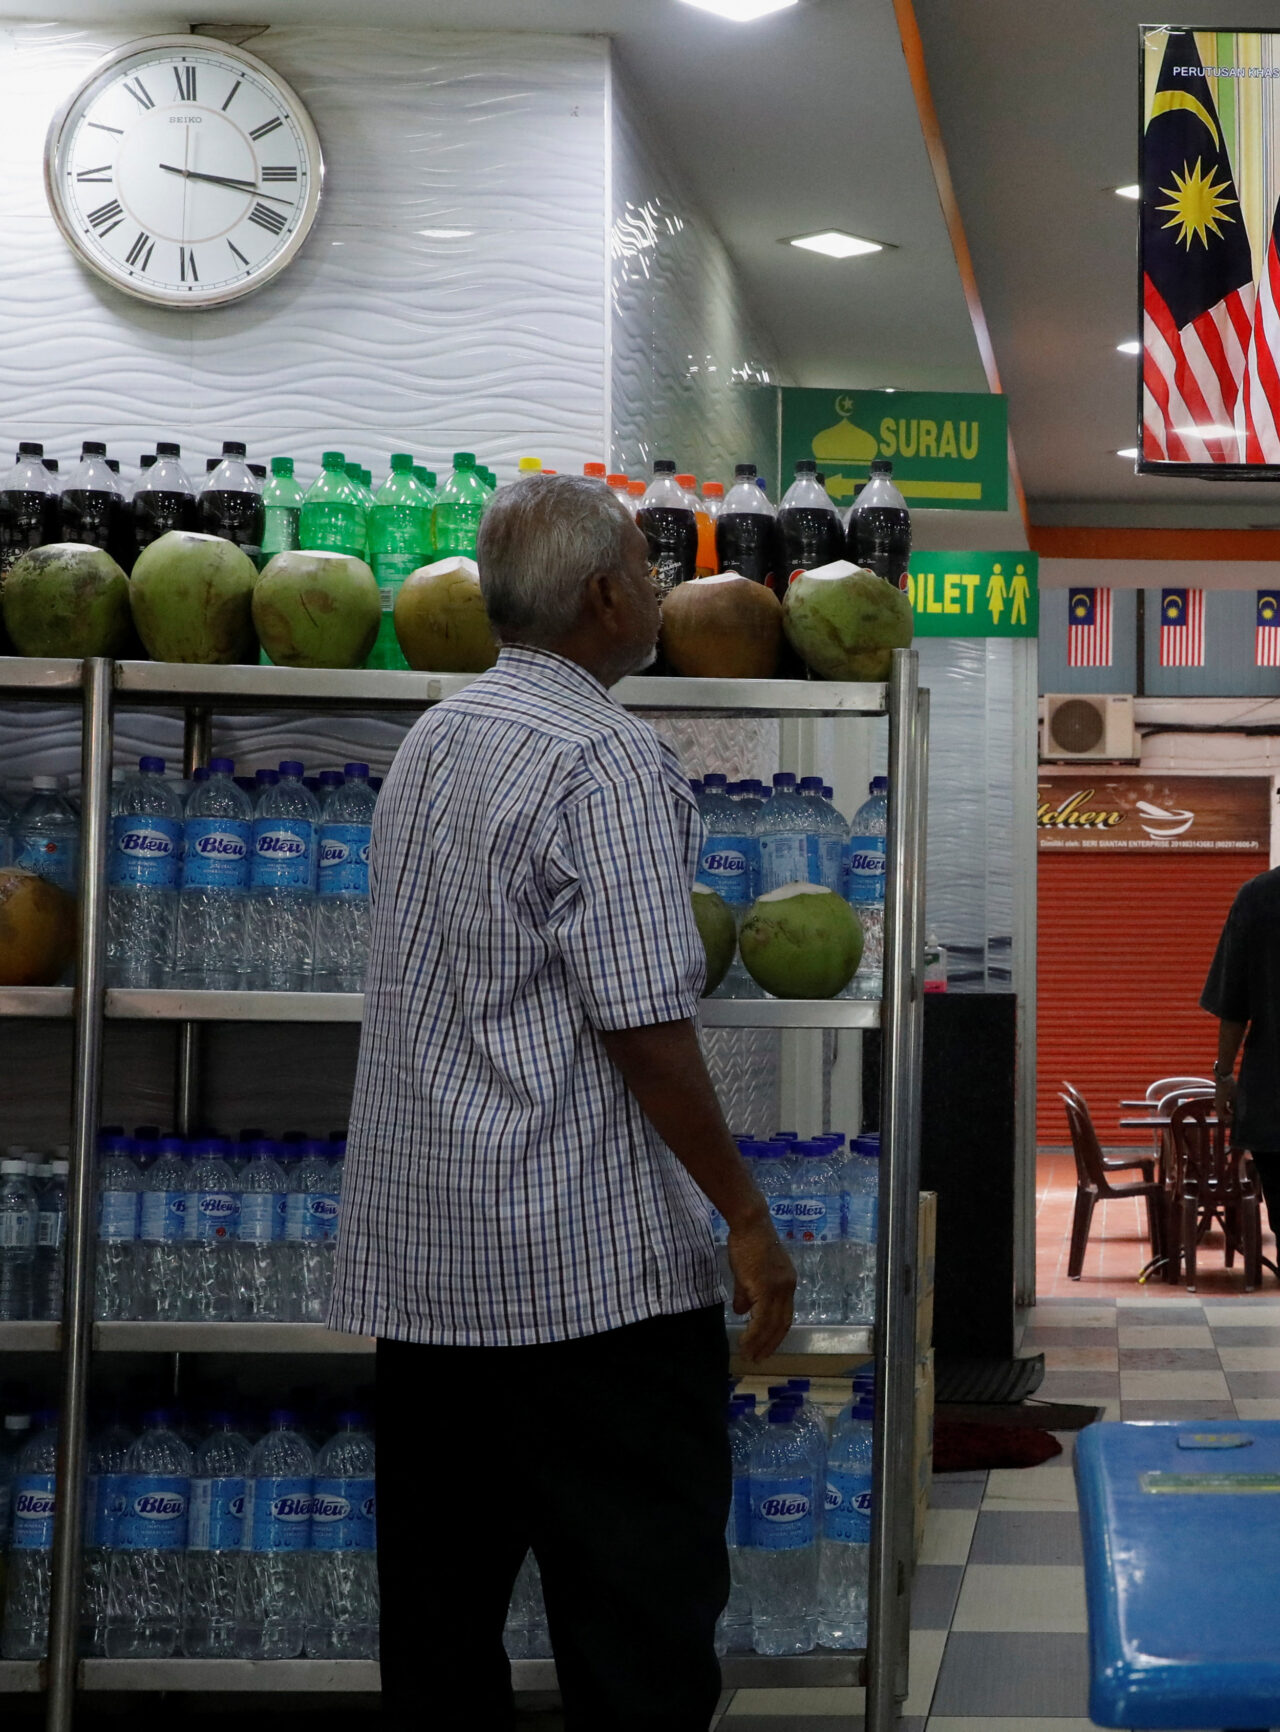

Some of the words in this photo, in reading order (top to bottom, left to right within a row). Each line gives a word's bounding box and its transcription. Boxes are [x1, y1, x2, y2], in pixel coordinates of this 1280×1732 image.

[1173, 66, 1245, 77] PERUTUSAN
[1248, 68, 1280, 78] KHAS
[169, 116, 203, 124] SEIKO
[879, 417, 979, 459] SURAU
[122, 834, 171, 853] Bleu
[198, 837, 244, 856] Bleu
[258, 836, 303, 853] Bleu
[320, 844, 345, 860] leu
[704, 854, 745, 870] Bleu
[201, 1199, 233, 1212] Bleu
[794, 1203, 823, 1216] Bleu
[138, 1497, 182, 1514] Bleu
[762, 1499, 807, 1516] Bleu
